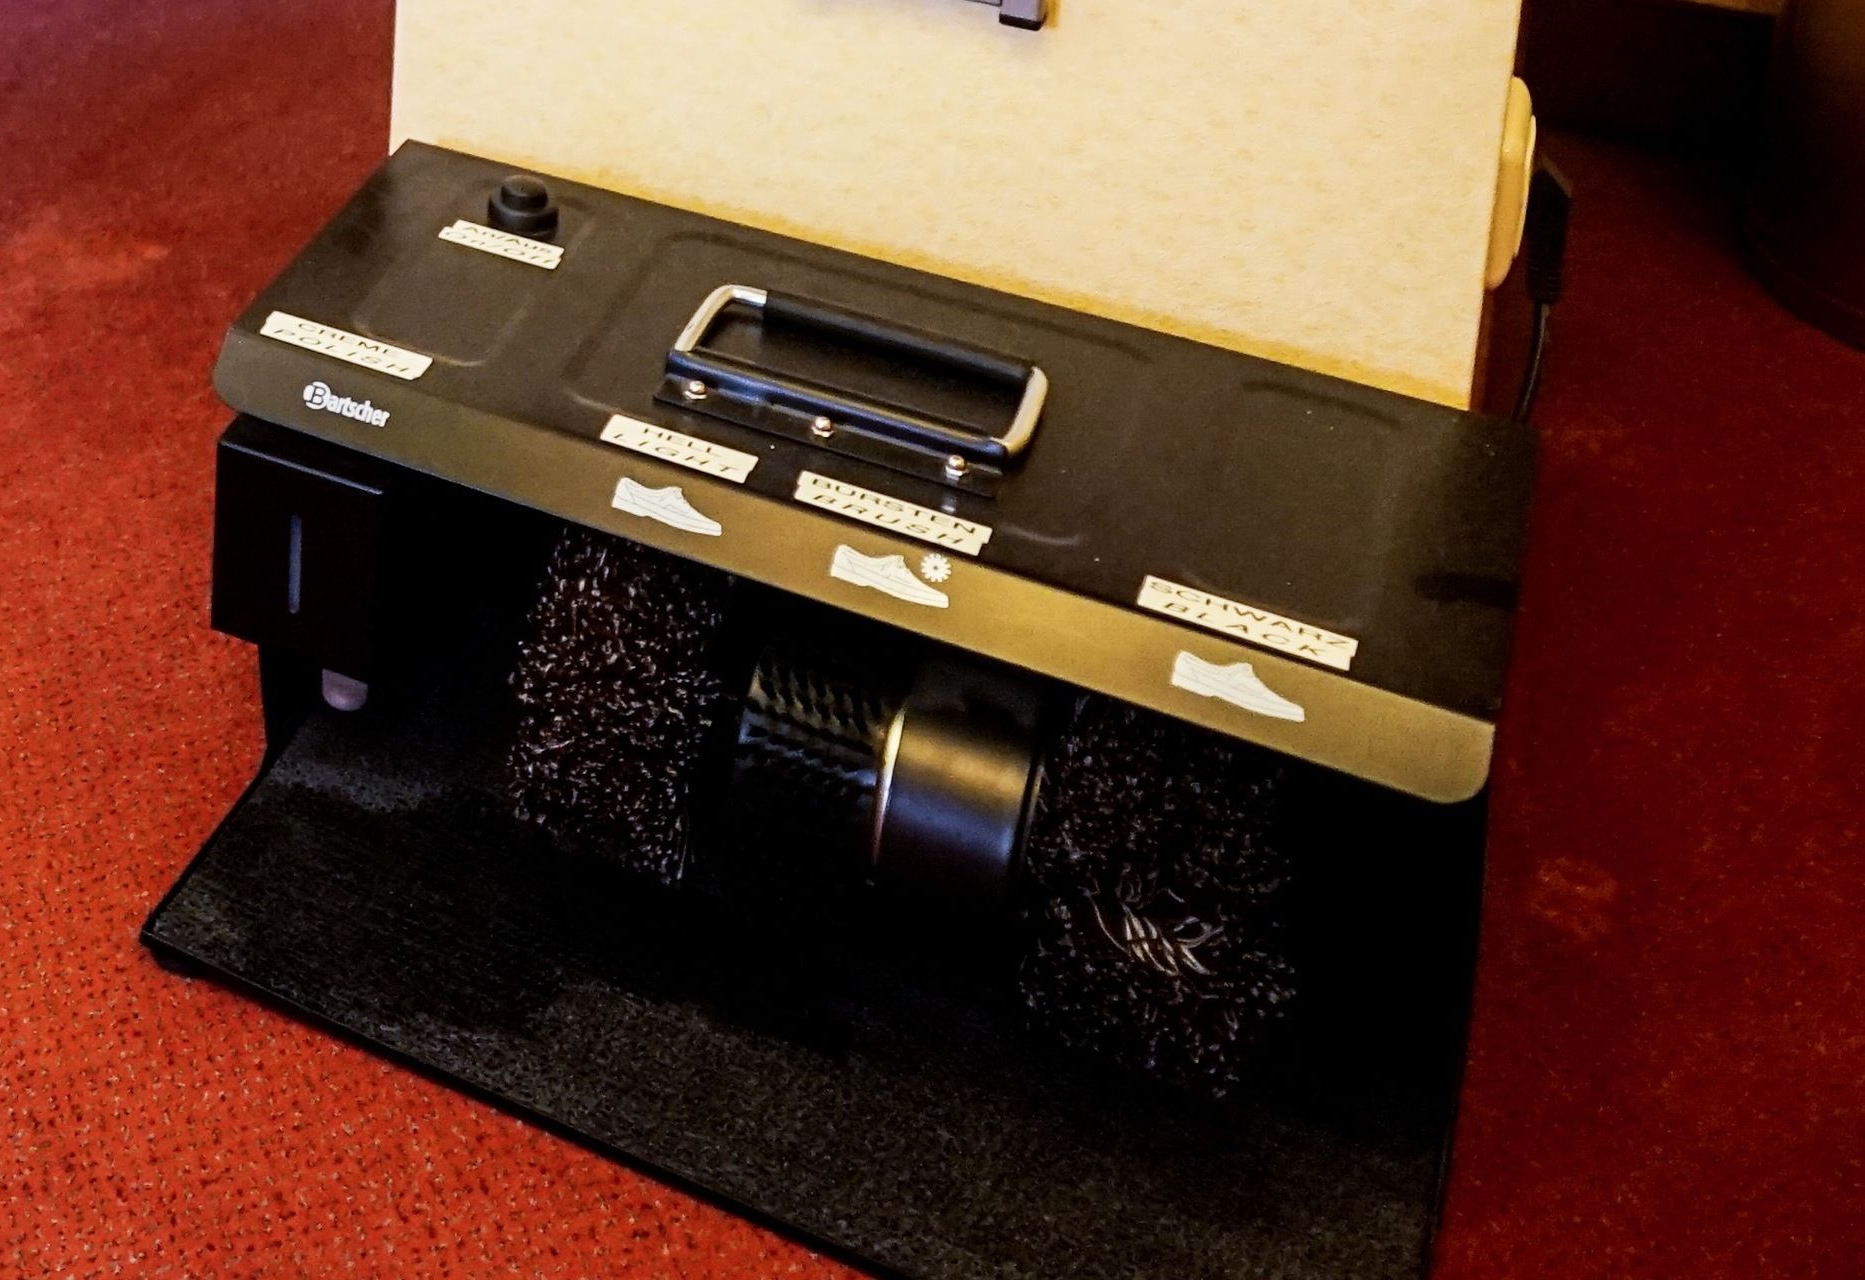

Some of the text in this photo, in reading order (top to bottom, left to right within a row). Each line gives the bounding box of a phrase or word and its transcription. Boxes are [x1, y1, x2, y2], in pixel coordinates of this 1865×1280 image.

[274, 328, 409, 373] POLISH
[298, 323, 398, 358] CREME
[303, 381, 390, 427] Bartscher
[613, 433, 742, 473] LIGHT
[644, 428, 722, 458] HELL
[813, 494, 964, 544] BRUSH
[1151, 581, 1350, 648] SCHWARZ
[1163, 603, 1327, 656] BLACK
